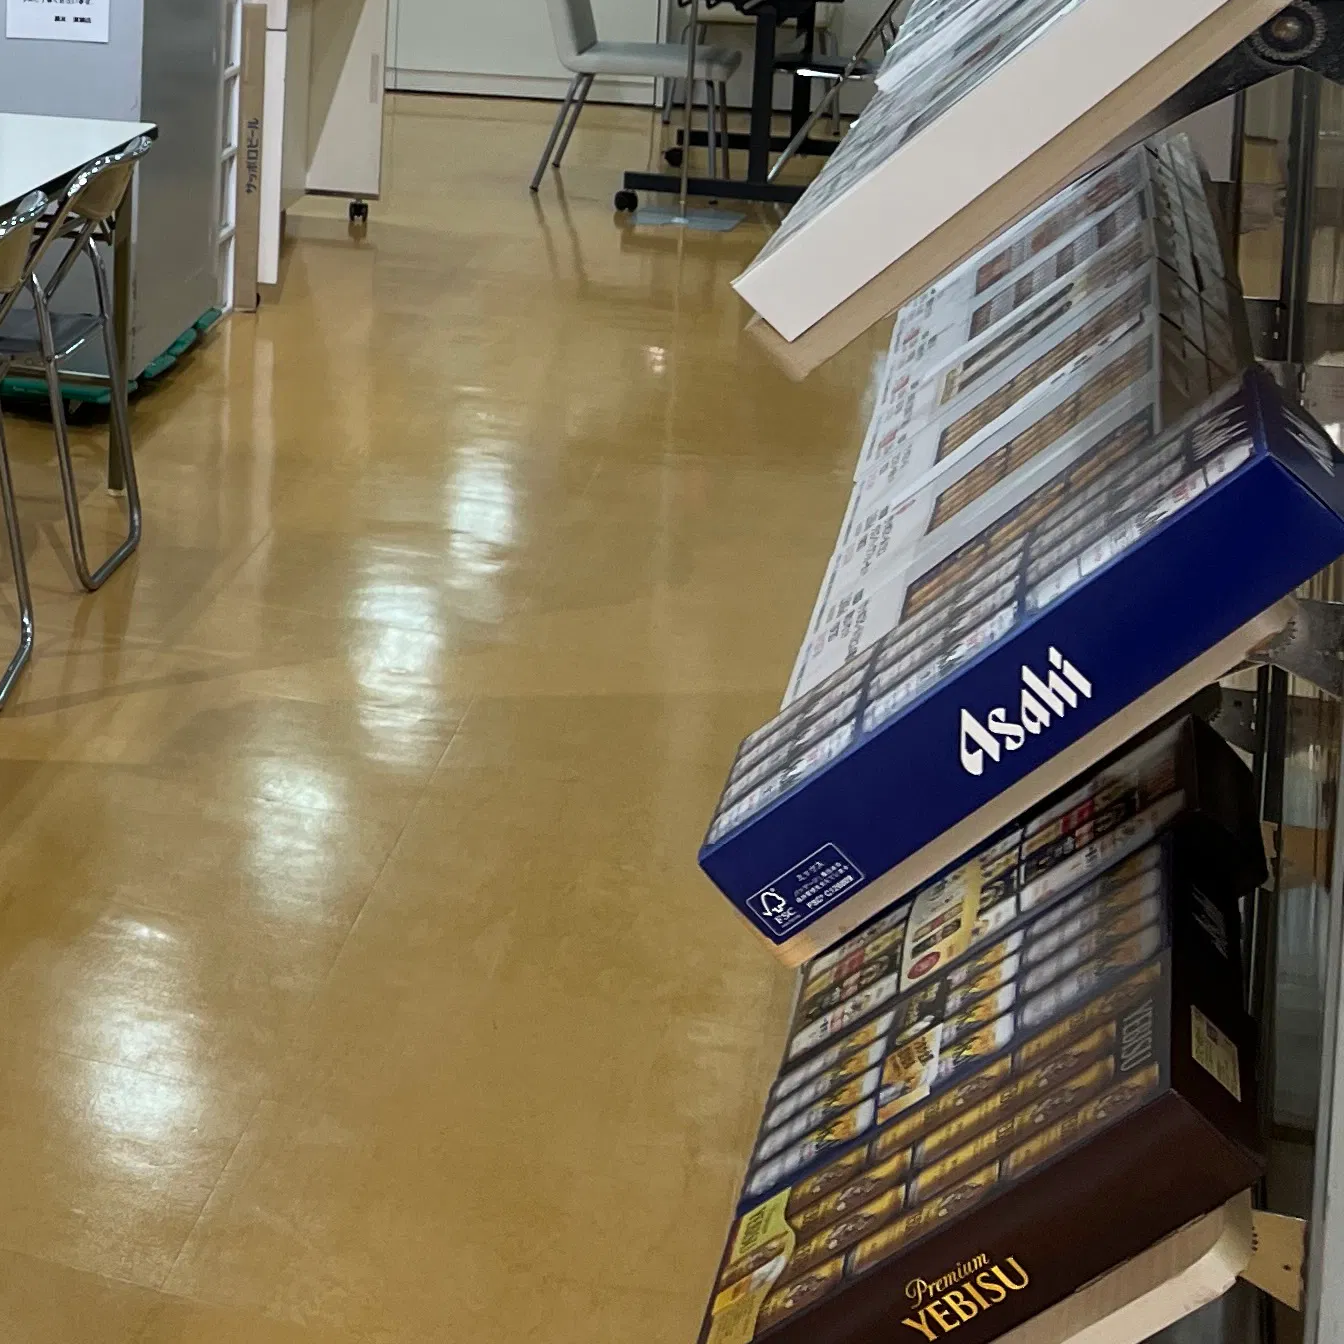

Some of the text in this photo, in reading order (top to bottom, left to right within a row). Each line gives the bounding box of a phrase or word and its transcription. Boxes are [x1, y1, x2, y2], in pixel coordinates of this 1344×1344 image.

[960, 645, 1094, 775] Asahi
[901, 1256, 1031, 1342] YEBISU
[905, 1251, 990, 1309] Premium
